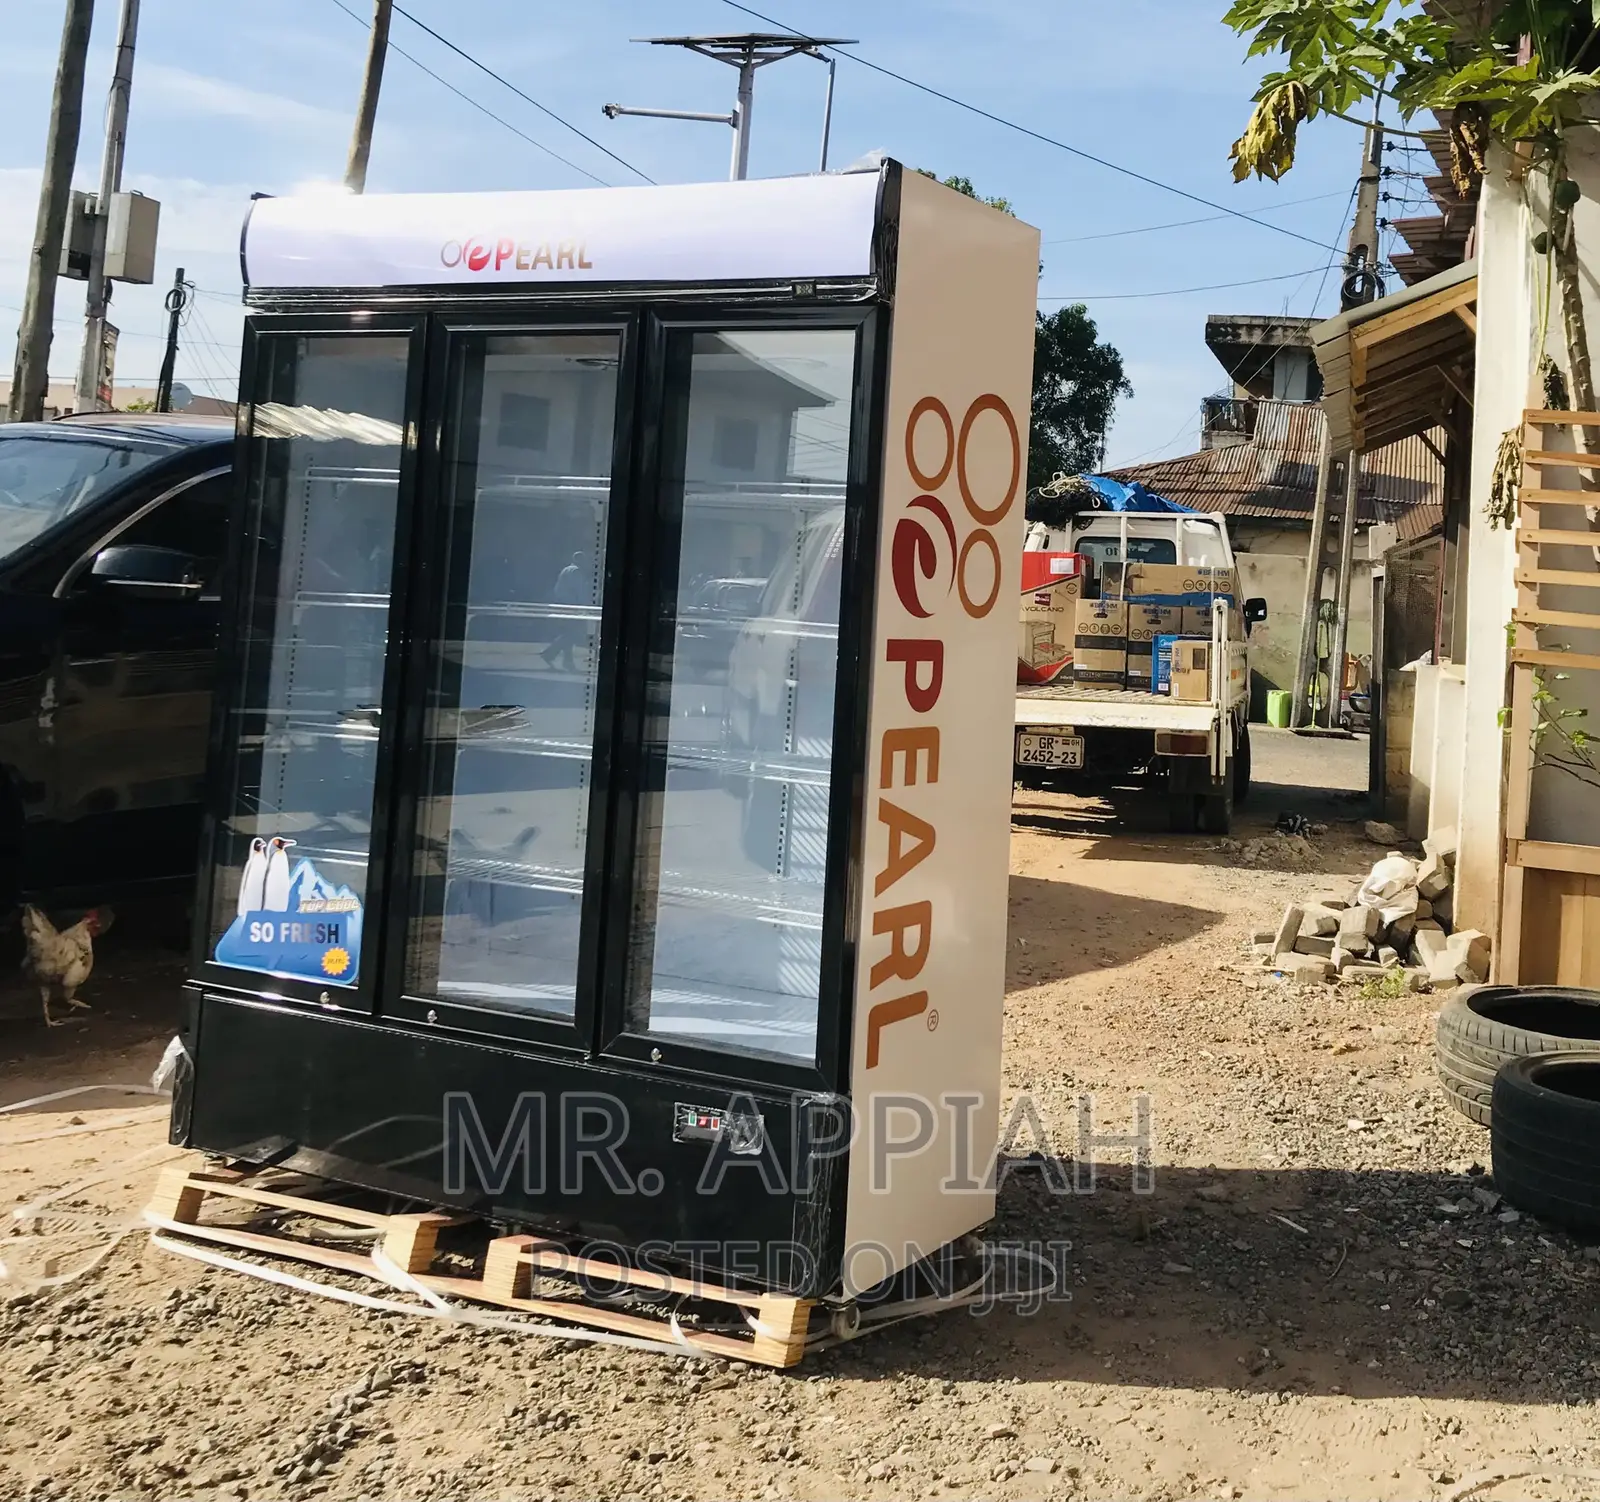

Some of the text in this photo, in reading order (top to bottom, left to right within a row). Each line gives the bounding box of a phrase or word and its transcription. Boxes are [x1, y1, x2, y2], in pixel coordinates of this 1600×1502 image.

[495, 235, 593, 271] PEARL
[1025, 605, 1065, 613] VOLCANO
[1039, 737, 1054, 750] GR
[1023, 749, 1077, 765] 2452-23
[250, 921, 340, 944] SO FRESH
